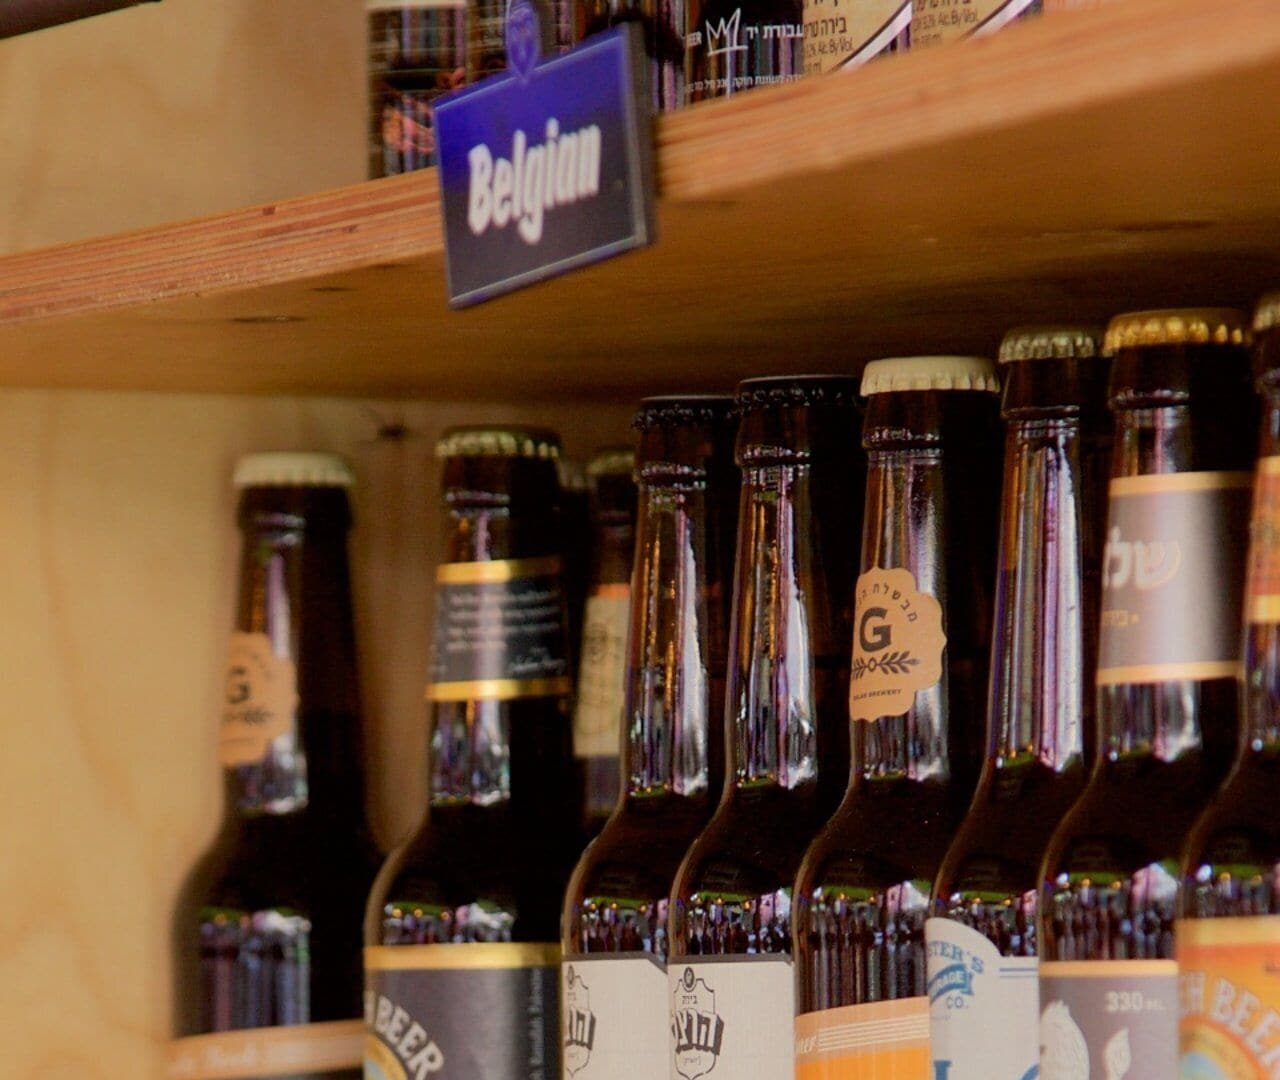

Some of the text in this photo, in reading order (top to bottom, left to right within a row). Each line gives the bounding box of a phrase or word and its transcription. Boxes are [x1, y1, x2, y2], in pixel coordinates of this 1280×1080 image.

[468, 117, 601, 245] Belgian
[859, 607, 892, 653] G
[928, 941, 984, 975] STER'S
[1105, 991, 1144, 1012] 330
